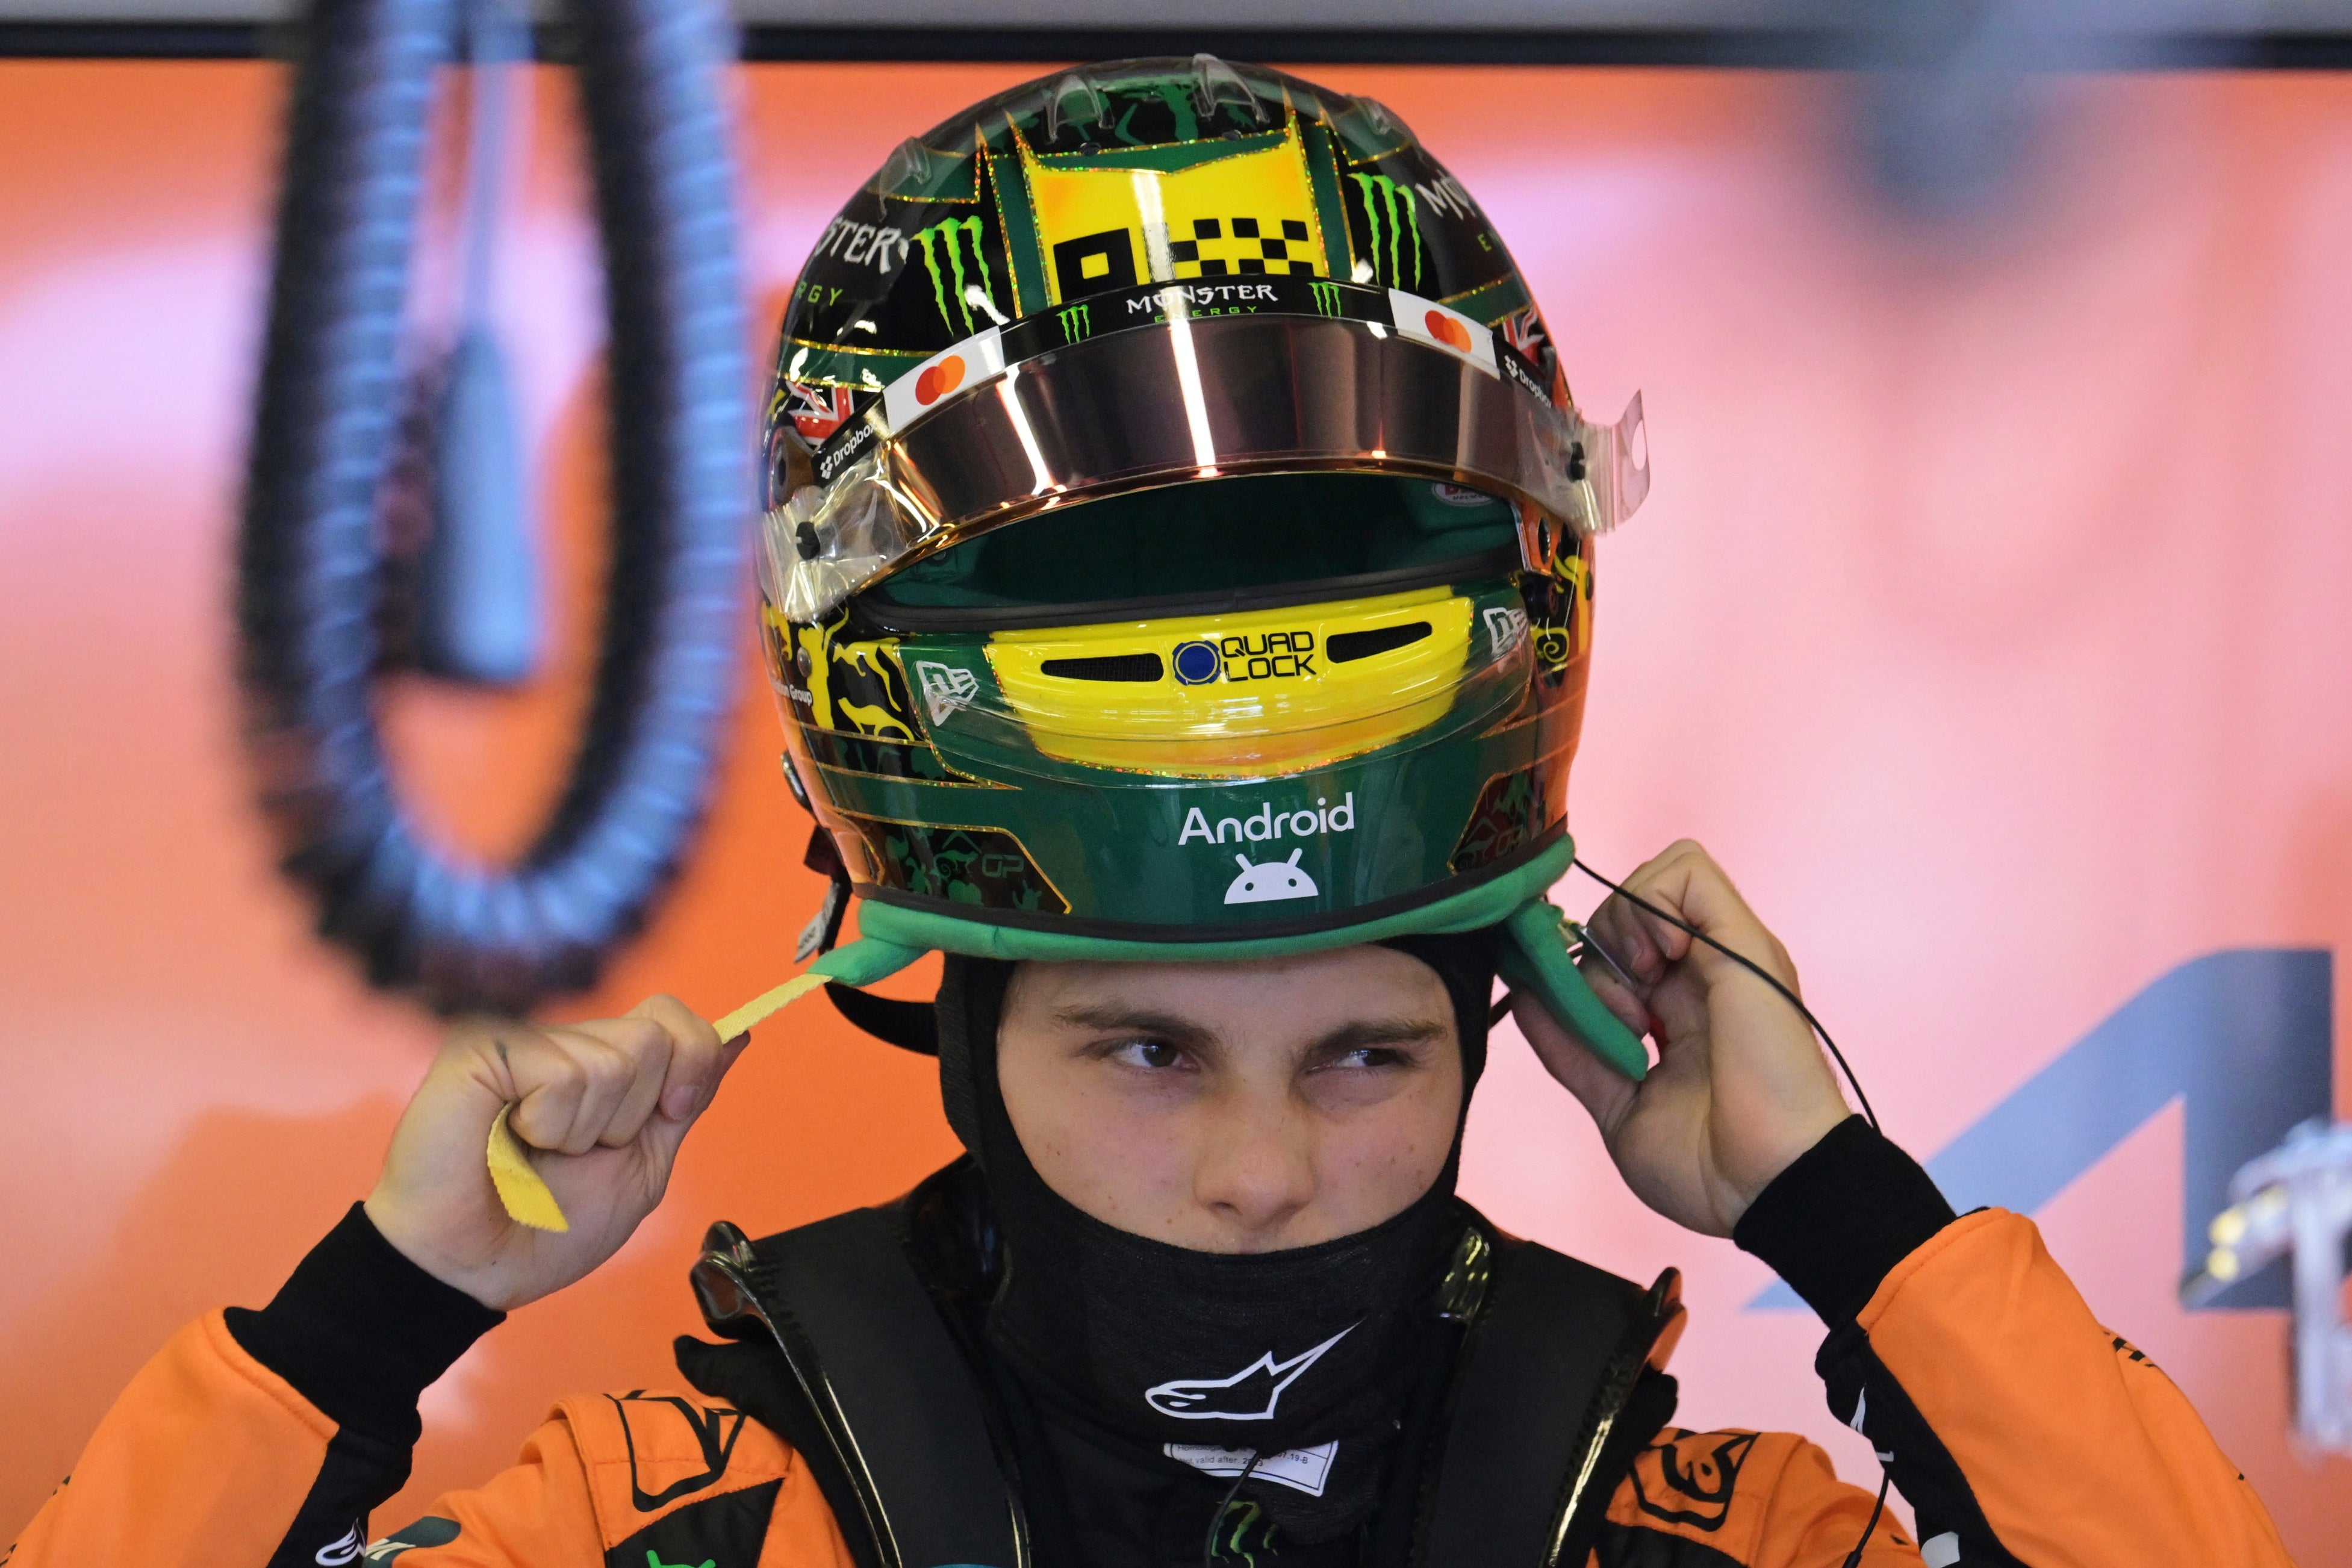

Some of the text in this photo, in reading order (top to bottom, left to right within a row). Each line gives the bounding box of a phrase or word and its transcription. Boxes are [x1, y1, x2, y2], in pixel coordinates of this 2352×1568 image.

[1125, 284, 1279, 314] MONSTER
[1154, 306, 1257, 323] ENERGY
[833, 420, 877, 467] Dropbox
[1220, 630, 1314, 658] QUAD
[1223, 653, 1317, 682] LOCK
[789, 683, 813, 706] Group
[1178, 791, 1355, 845] Android
